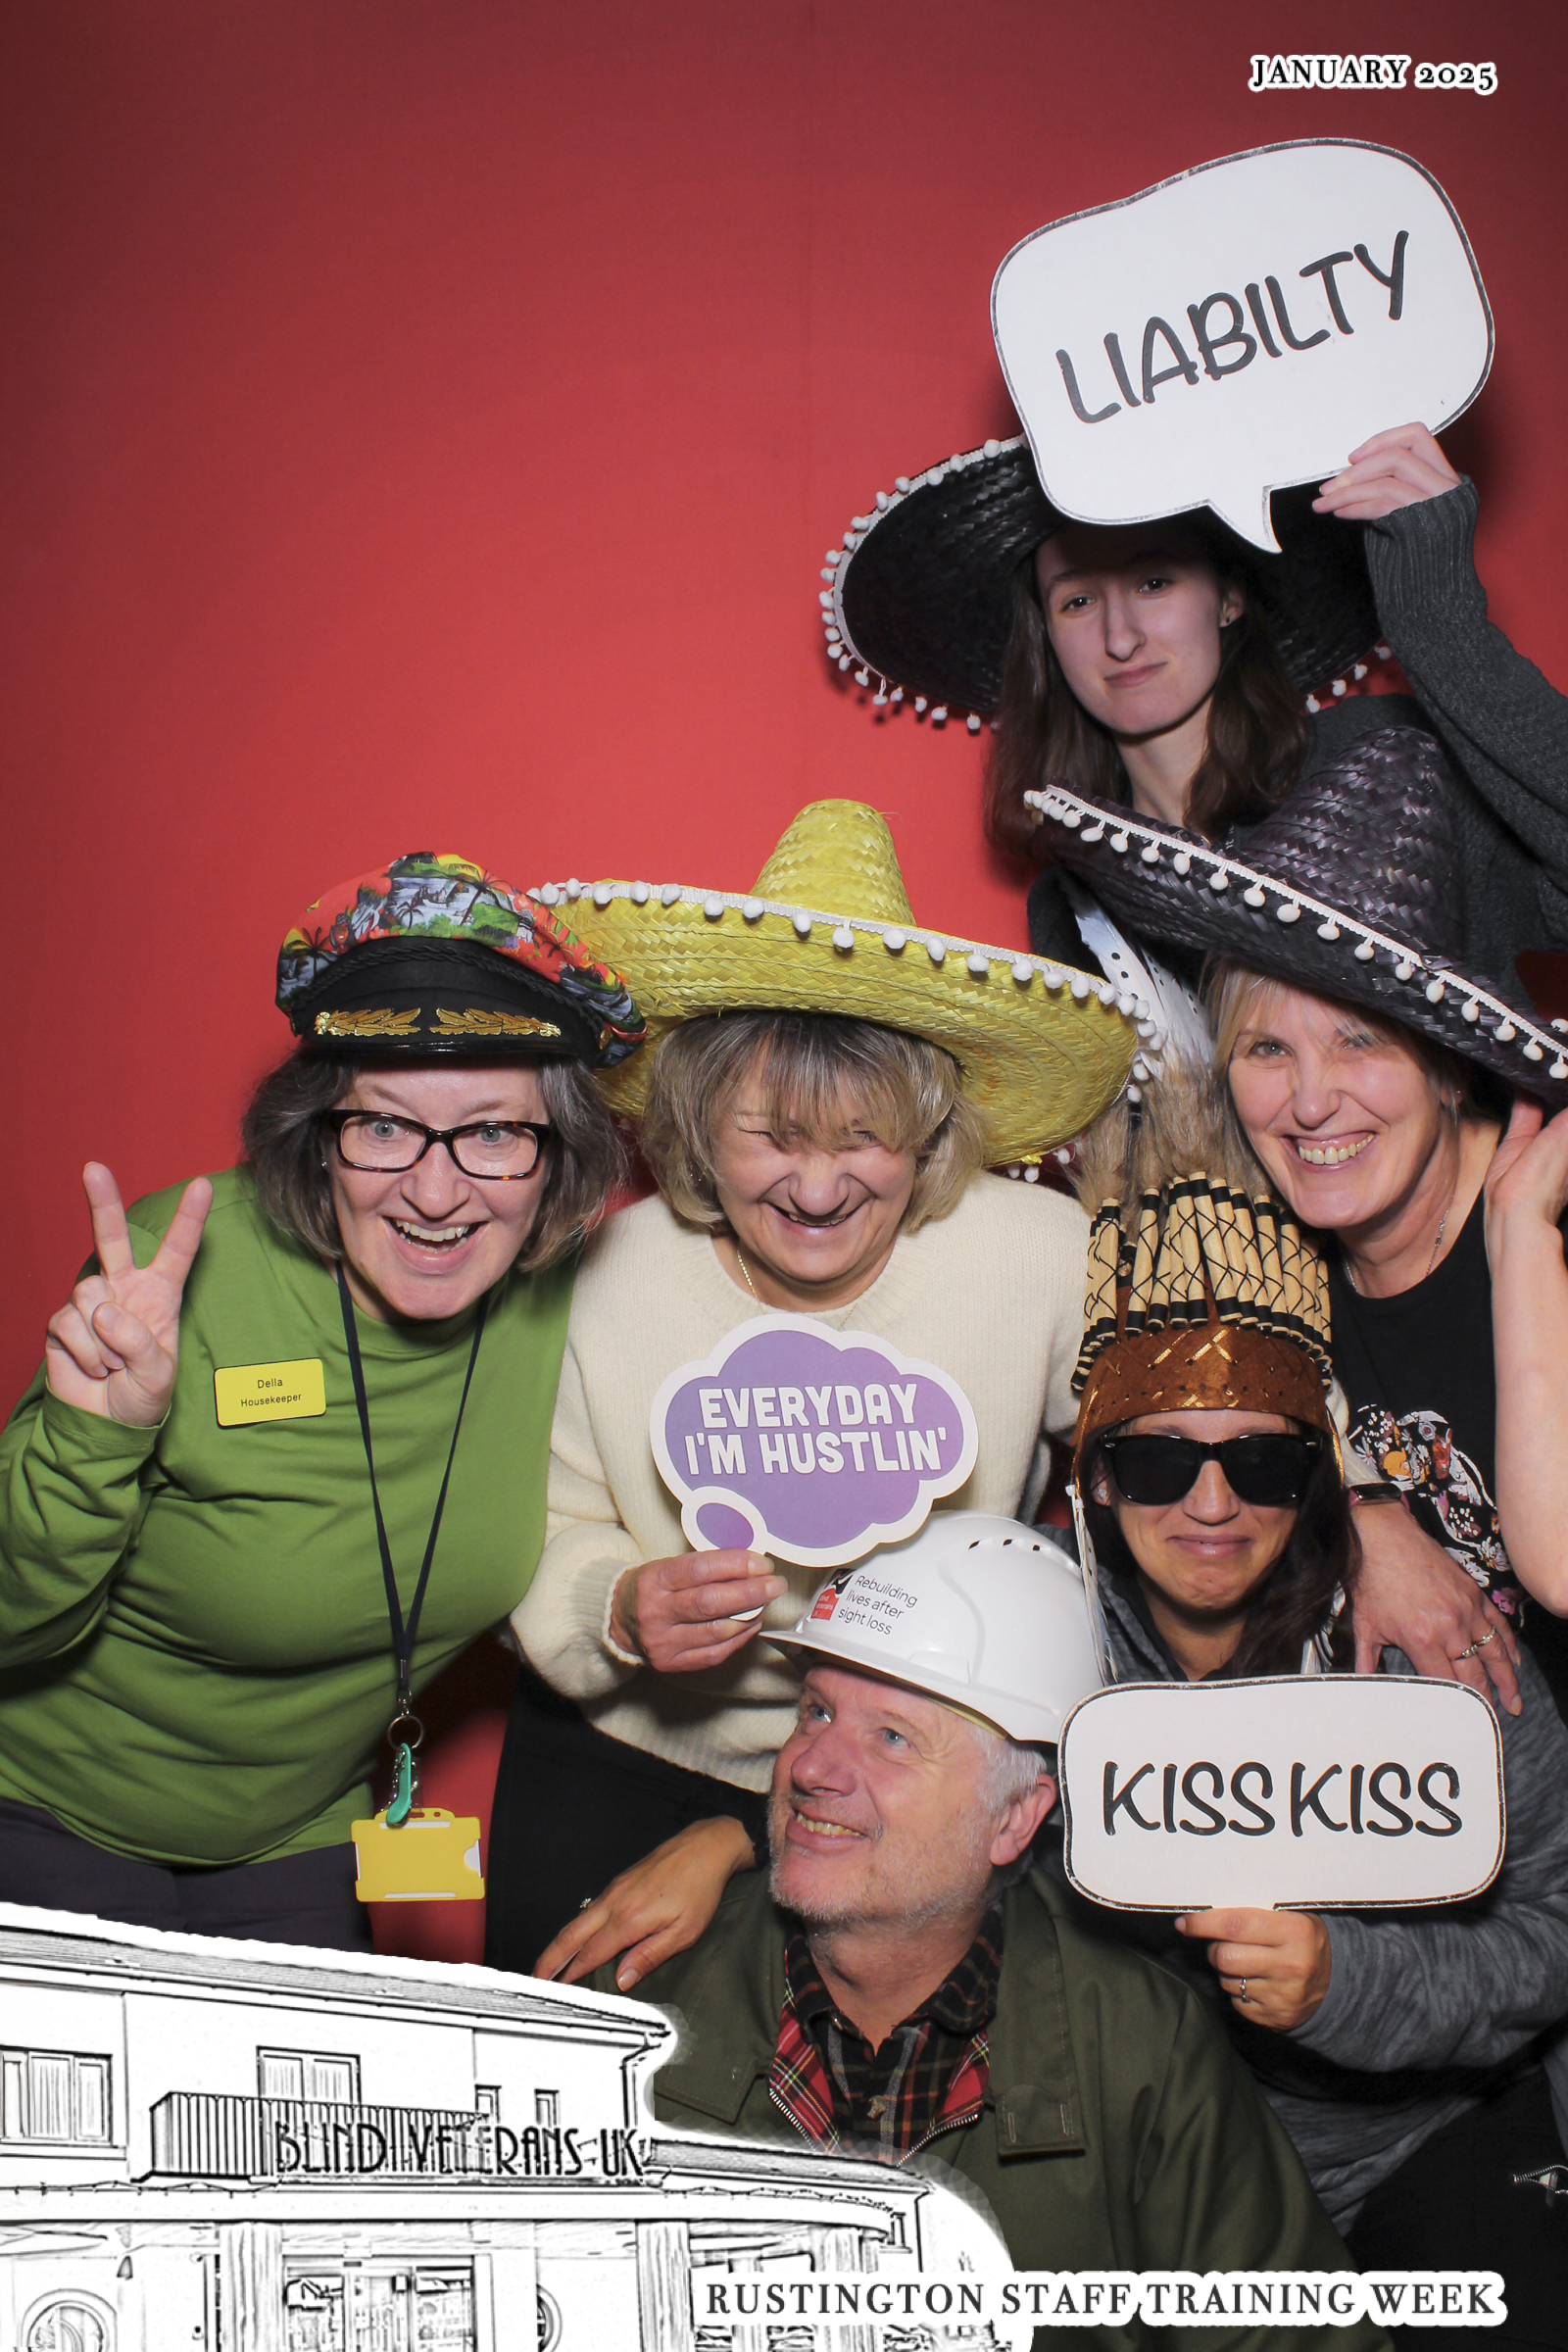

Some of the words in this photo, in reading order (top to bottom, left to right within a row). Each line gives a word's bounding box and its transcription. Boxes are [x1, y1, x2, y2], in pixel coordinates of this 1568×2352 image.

[1054, 229, 1410, 424] LIABILTY
[257, 1378, 283, 1389] Della
[240, 1394, 302, 1407] Housekeeper
[698, 1383, 917, 1429] EVERYDAY
[684, 1431, 748, 1475] I'M
[759, 1426, 948, 1474] HUSTLIN'
[846, 1590, 871, 1607] lives
[871, 1599, 905, 1619] after
[855, 1575, 918, 1608] Rebuilding
[838, 1607, 866, 1625] sight
[866, 1615, 893, 1636] loss
[1102, 1761, 1276, 1838] KISS
[1290, 1761, 1462, 1838] KISS
